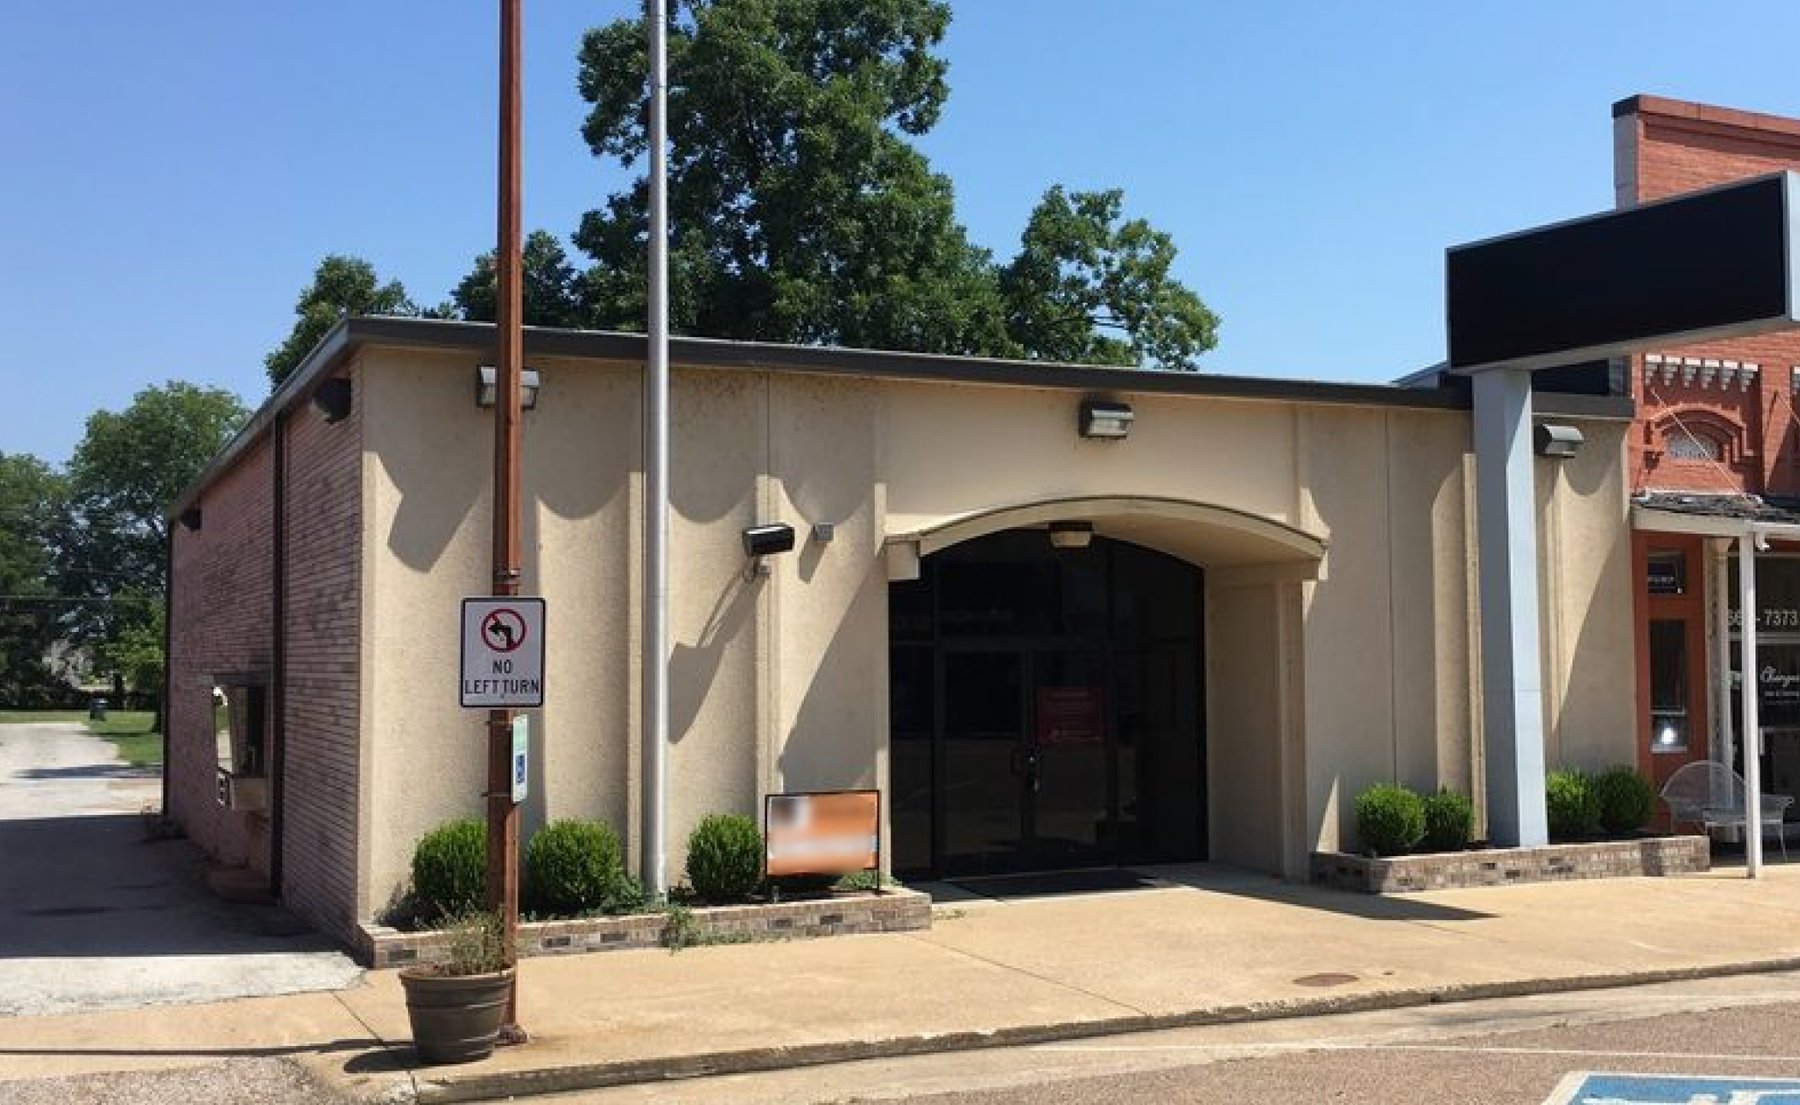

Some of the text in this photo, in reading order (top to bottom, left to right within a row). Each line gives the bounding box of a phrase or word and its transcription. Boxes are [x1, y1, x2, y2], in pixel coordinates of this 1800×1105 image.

[1764, 609, 1797, 626] 7373
[492, 659, 512, 674] NO
[465, 679, 539, 694] LEFT TURN
